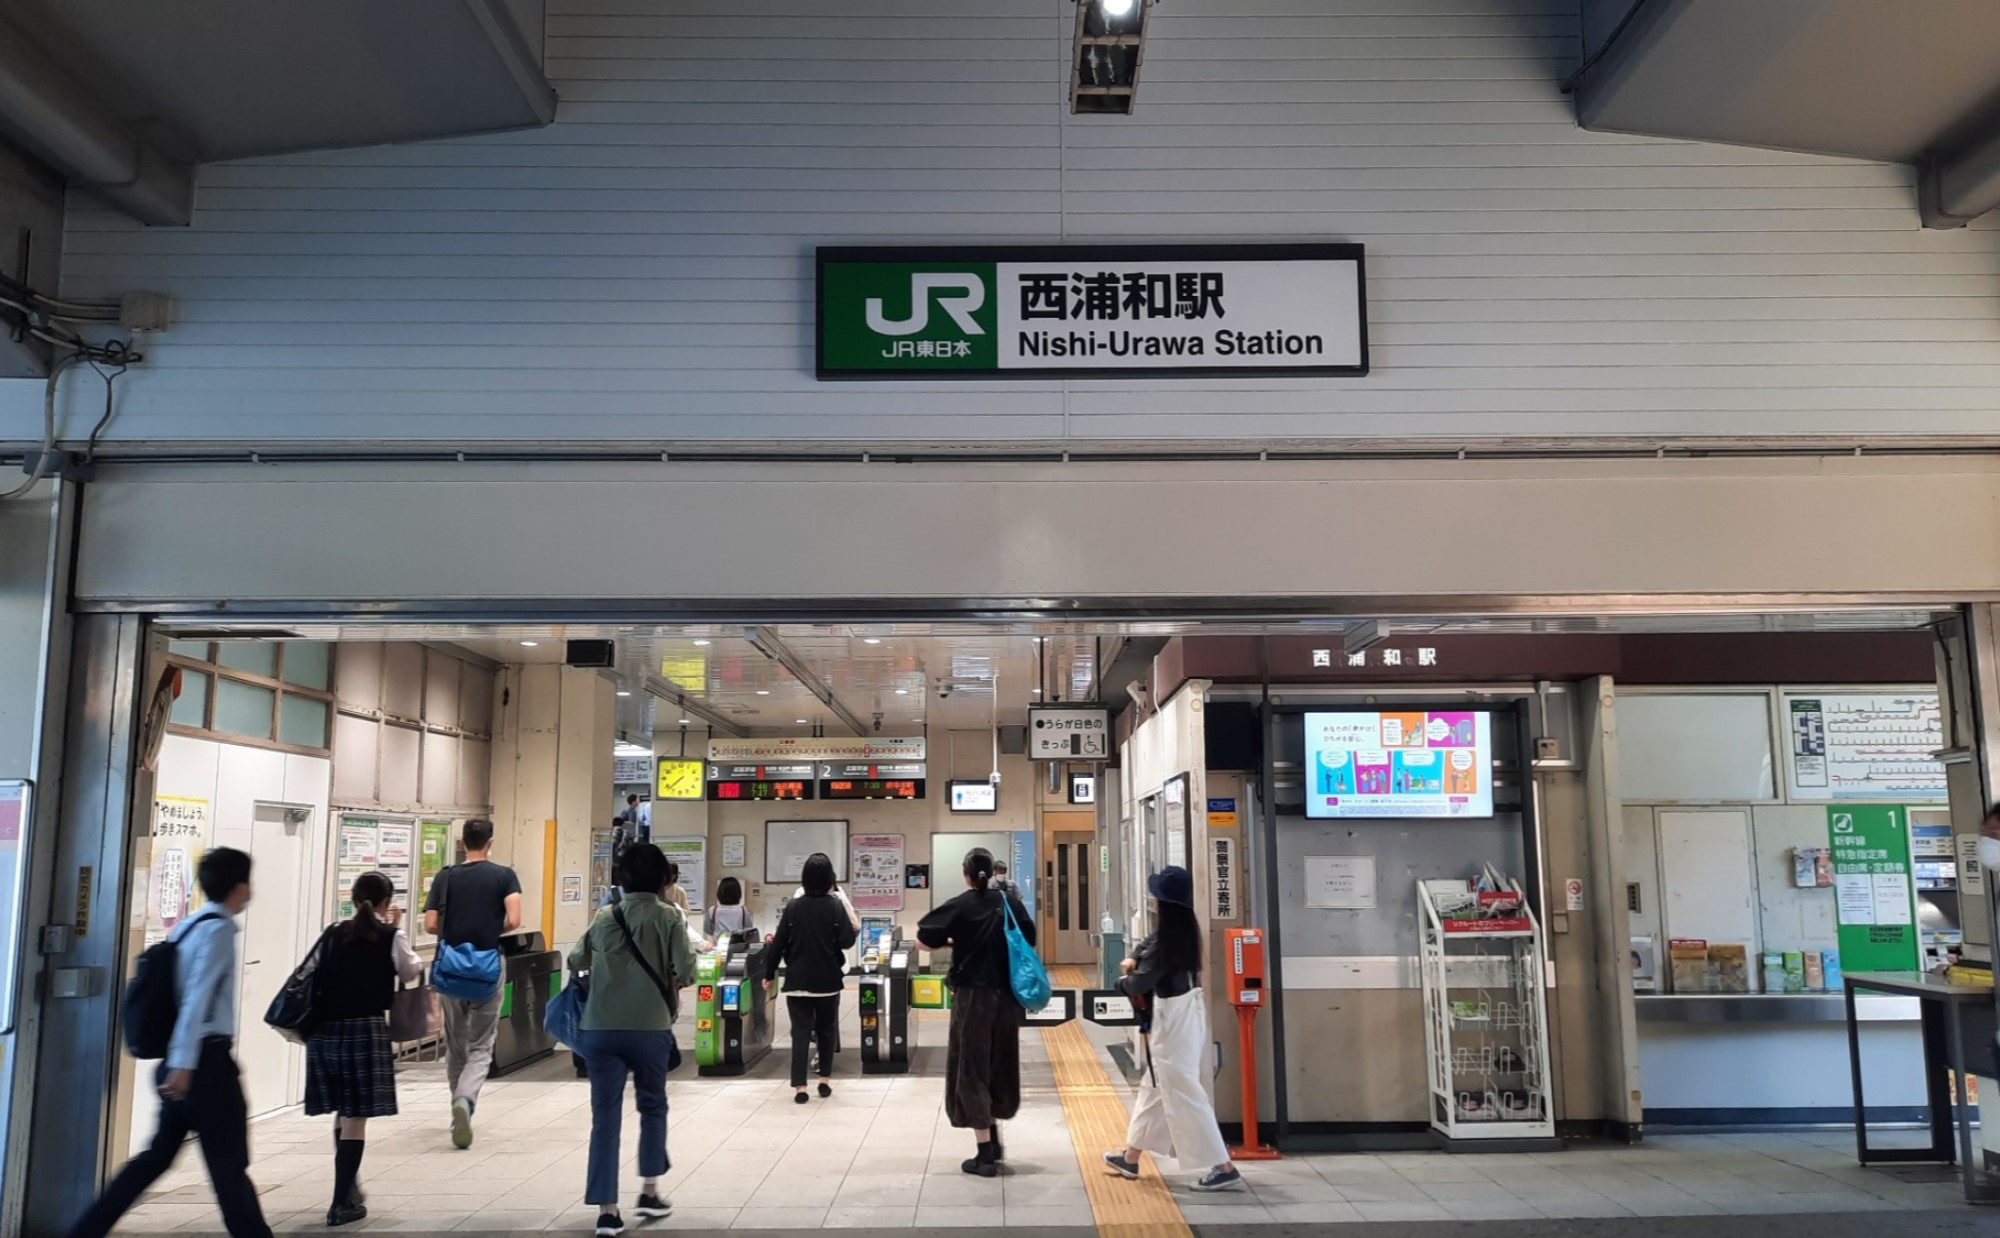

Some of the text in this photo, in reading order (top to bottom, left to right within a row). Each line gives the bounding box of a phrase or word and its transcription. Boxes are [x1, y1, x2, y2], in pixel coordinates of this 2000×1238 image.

[866, 272, 986, 336] JR
[1018, 272, 1226, 320] 西浦和駅
[881, 340, 972, 358] JR東日本
[1018, 330, 1323, 357] Nishi-Urawa Station
[710, 766, 720, 779] 3
[822, 765, 832, 777] 2
[1888, 811, 1897, 828] 1
[1834, 836, 1866, 847] 新幹線
[1835, 849, 1888, 860] 特急指定席
[1215, 840, 1231, 917] 警察官立寄所
